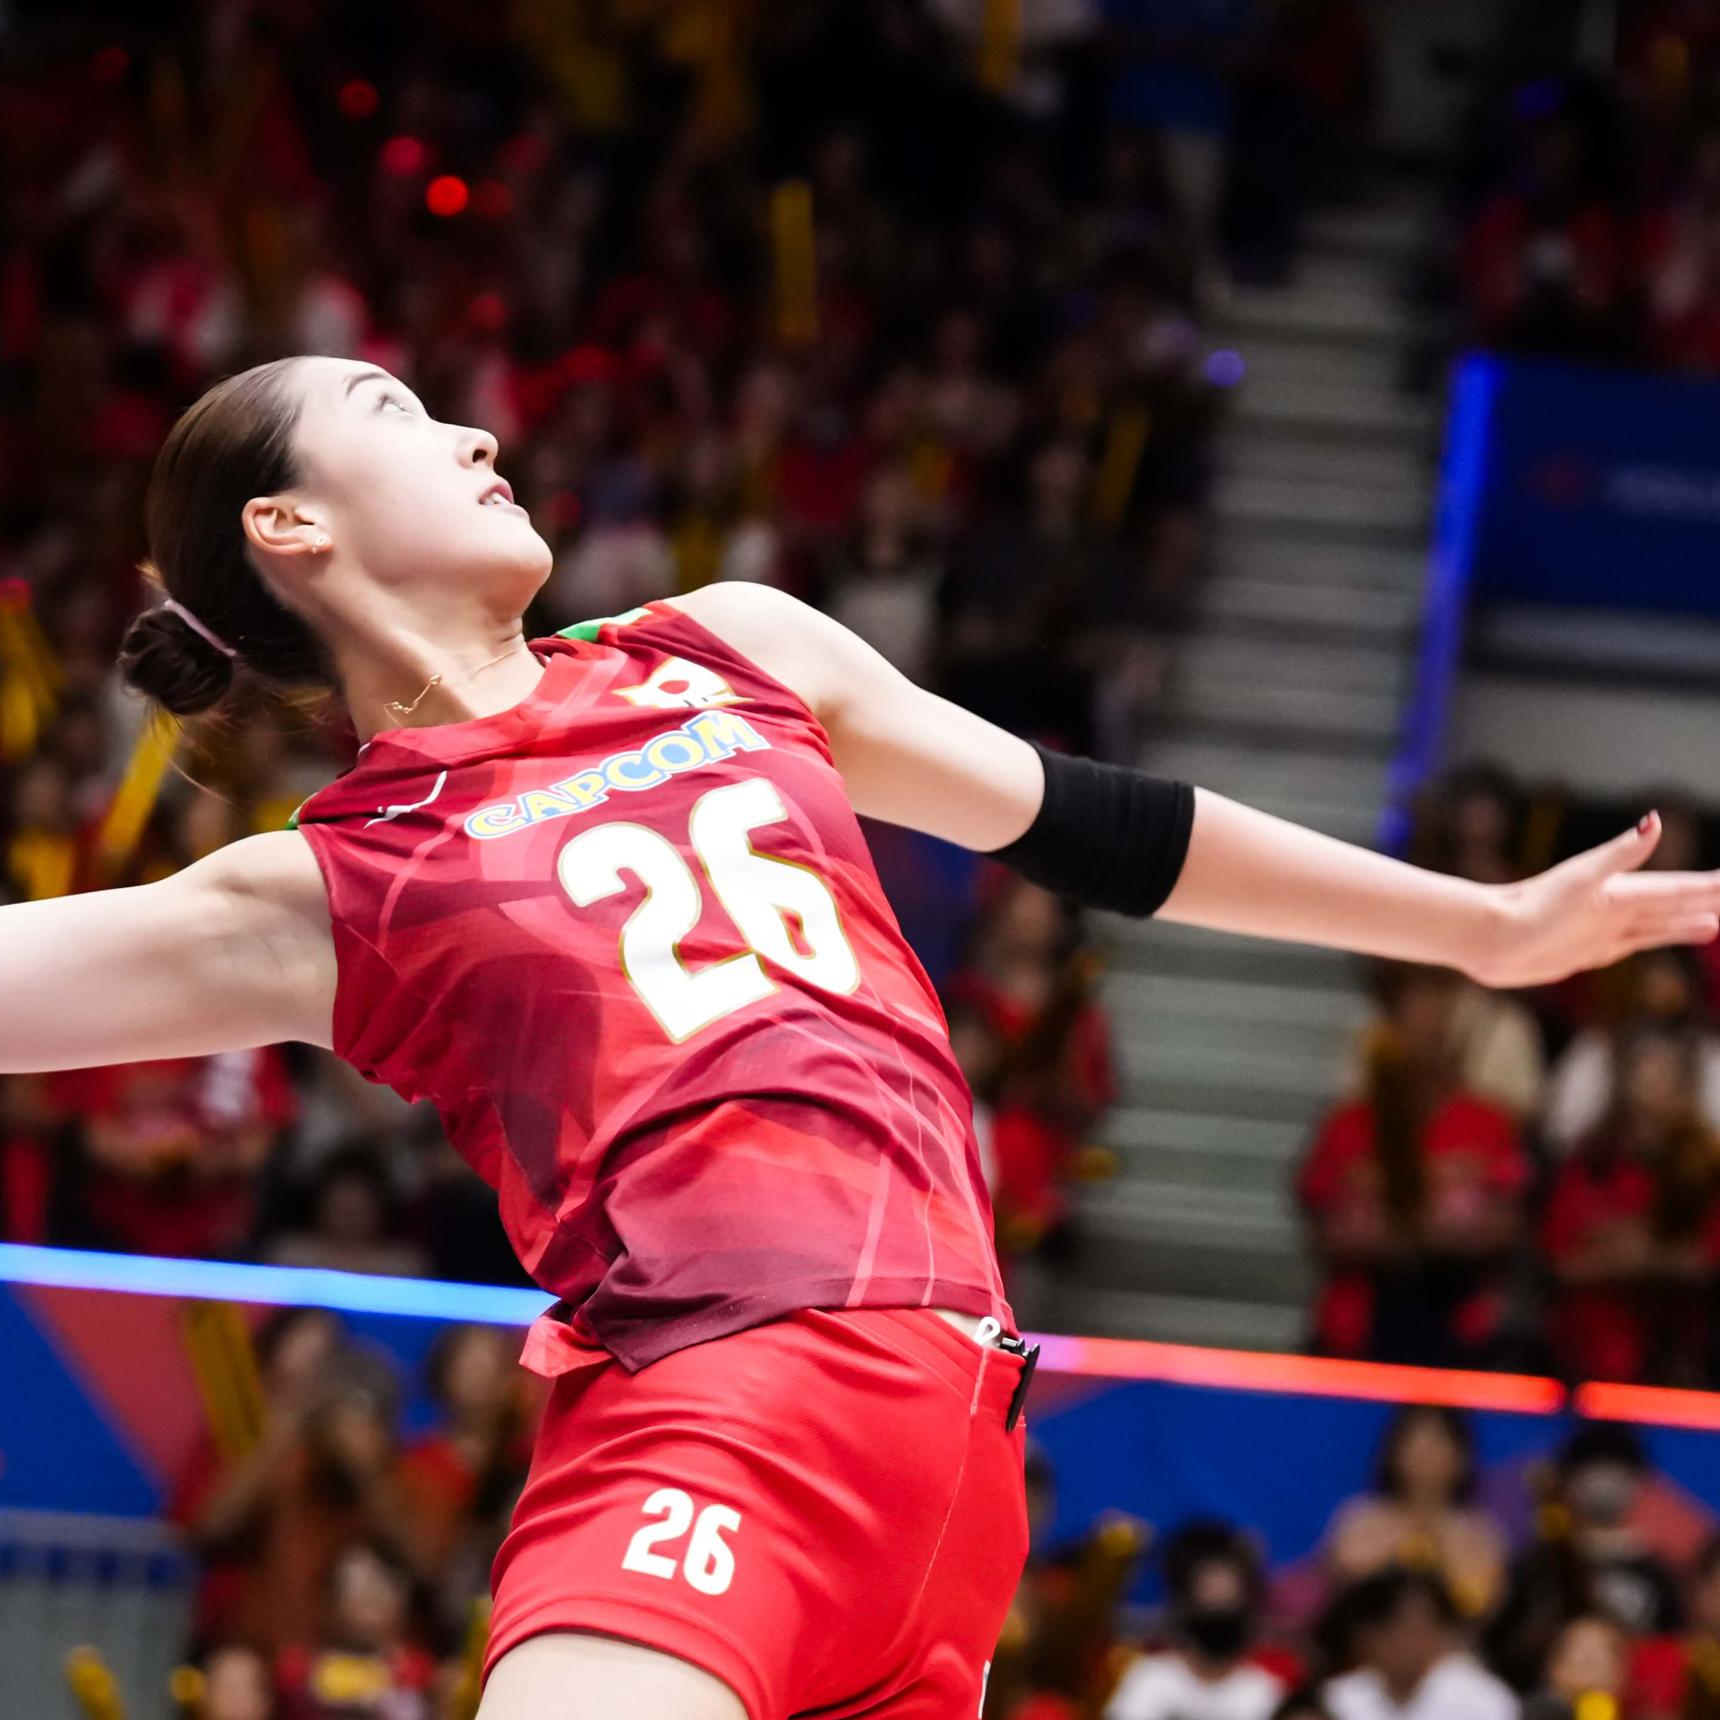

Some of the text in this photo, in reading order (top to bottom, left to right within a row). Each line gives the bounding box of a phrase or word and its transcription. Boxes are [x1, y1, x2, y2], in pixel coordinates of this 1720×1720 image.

[464, 710, 774, 839] CAPCOM
[557, 777, 861, 1045] 26
[622, 1488, 741, 1595] 26
